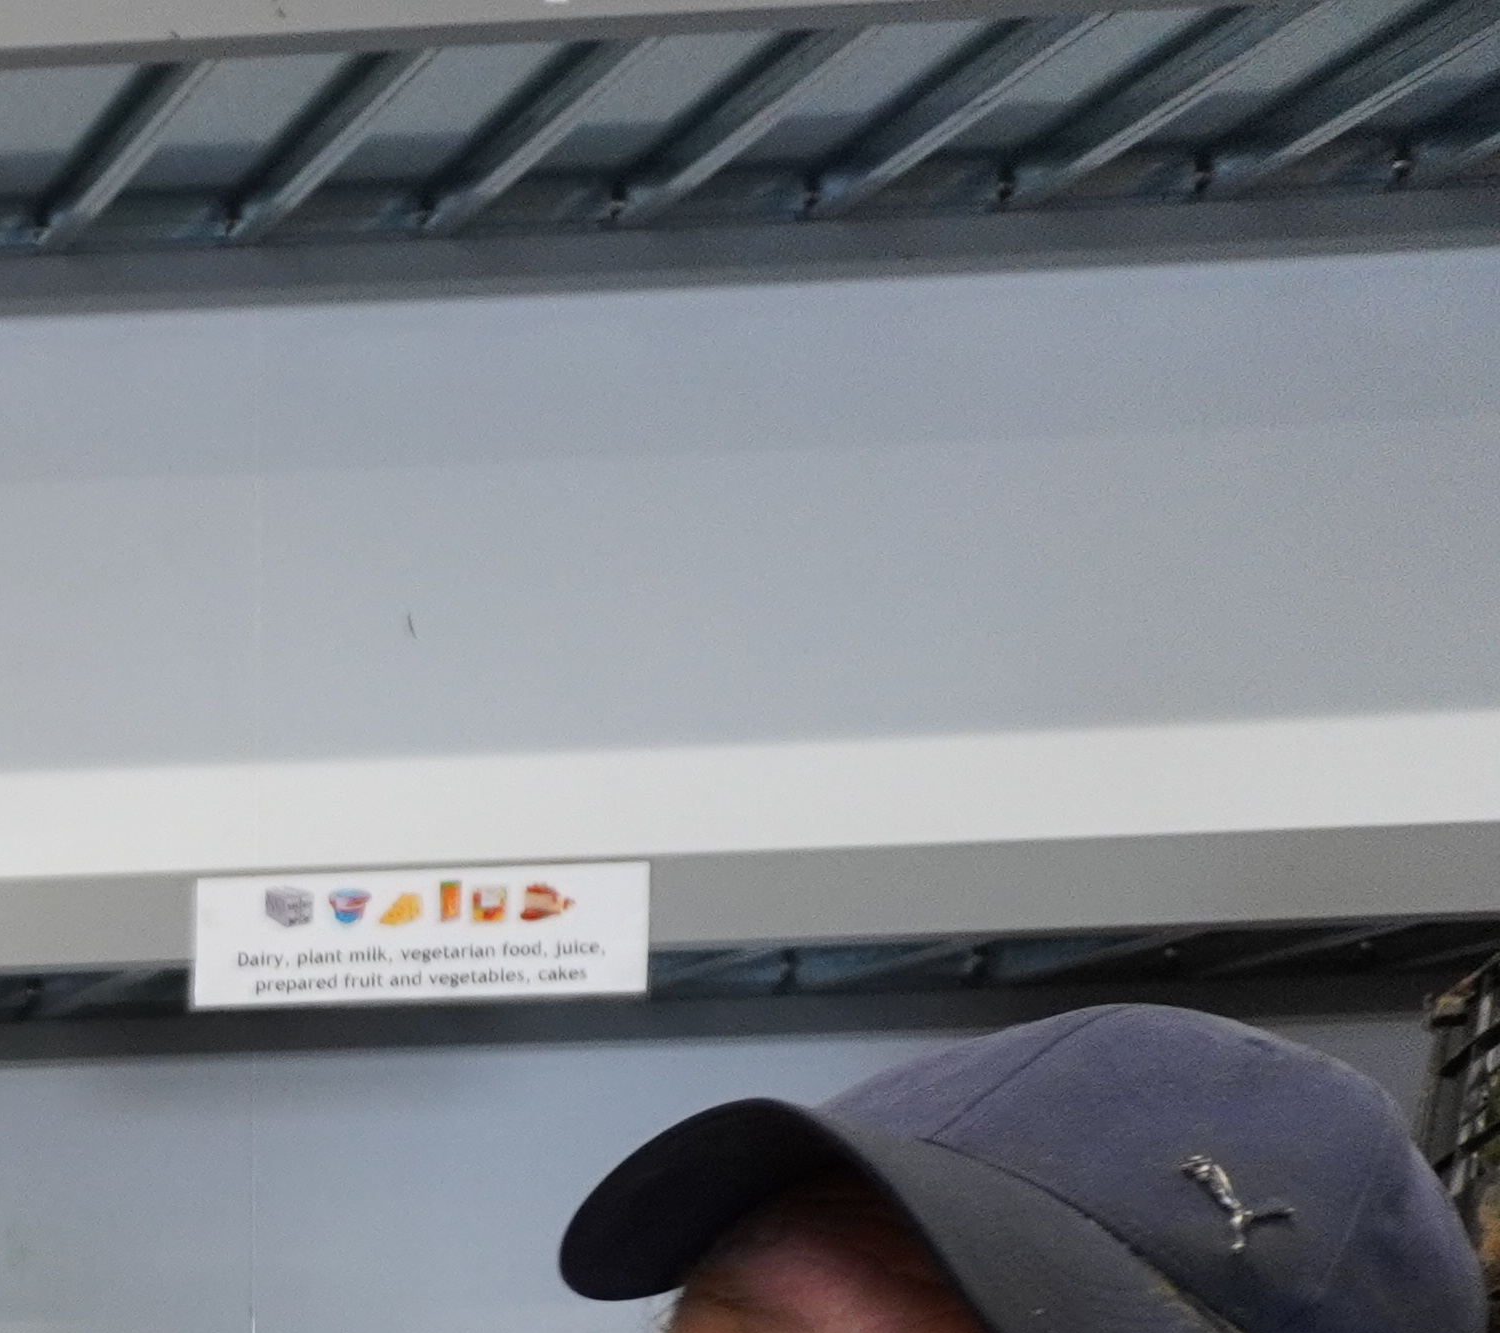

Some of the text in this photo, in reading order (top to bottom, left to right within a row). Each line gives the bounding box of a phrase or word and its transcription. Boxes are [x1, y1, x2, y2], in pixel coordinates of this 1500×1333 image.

[237, 939, 607, 968] Dairy, plant milk, vegetarian food, juice,
[255, 966, 587, 995] prepared fruit and vegetables, cakes
